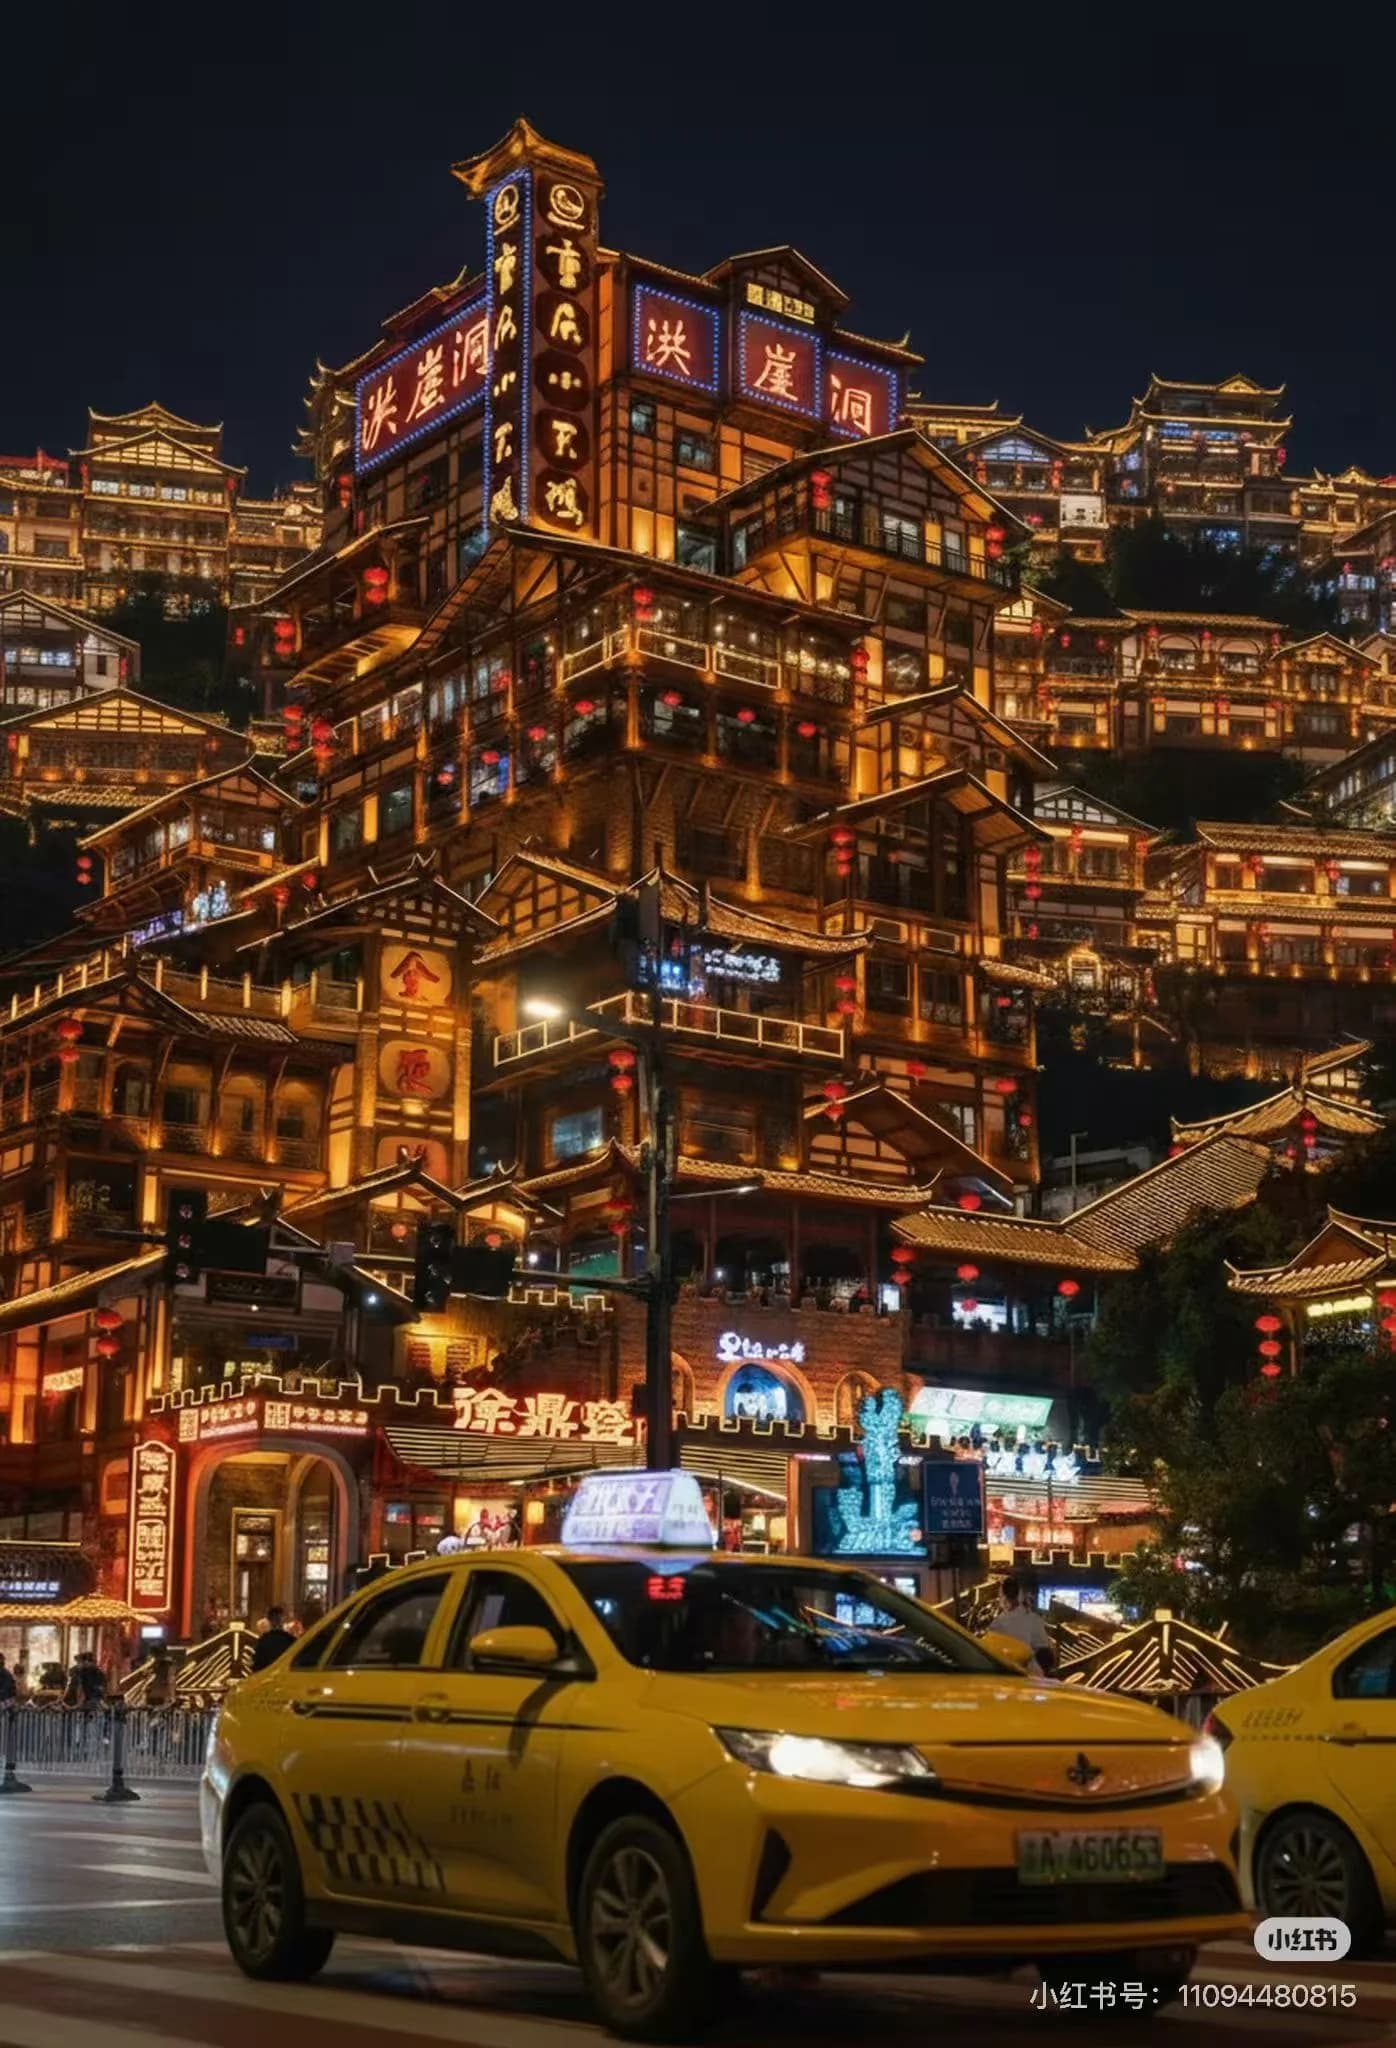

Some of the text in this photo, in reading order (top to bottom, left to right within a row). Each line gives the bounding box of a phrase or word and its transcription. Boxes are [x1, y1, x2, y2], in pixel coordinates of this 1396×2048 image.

[362, 318, 489, 451] 洪崖洞
[647, 319, 871, 436] 洪崖洞
